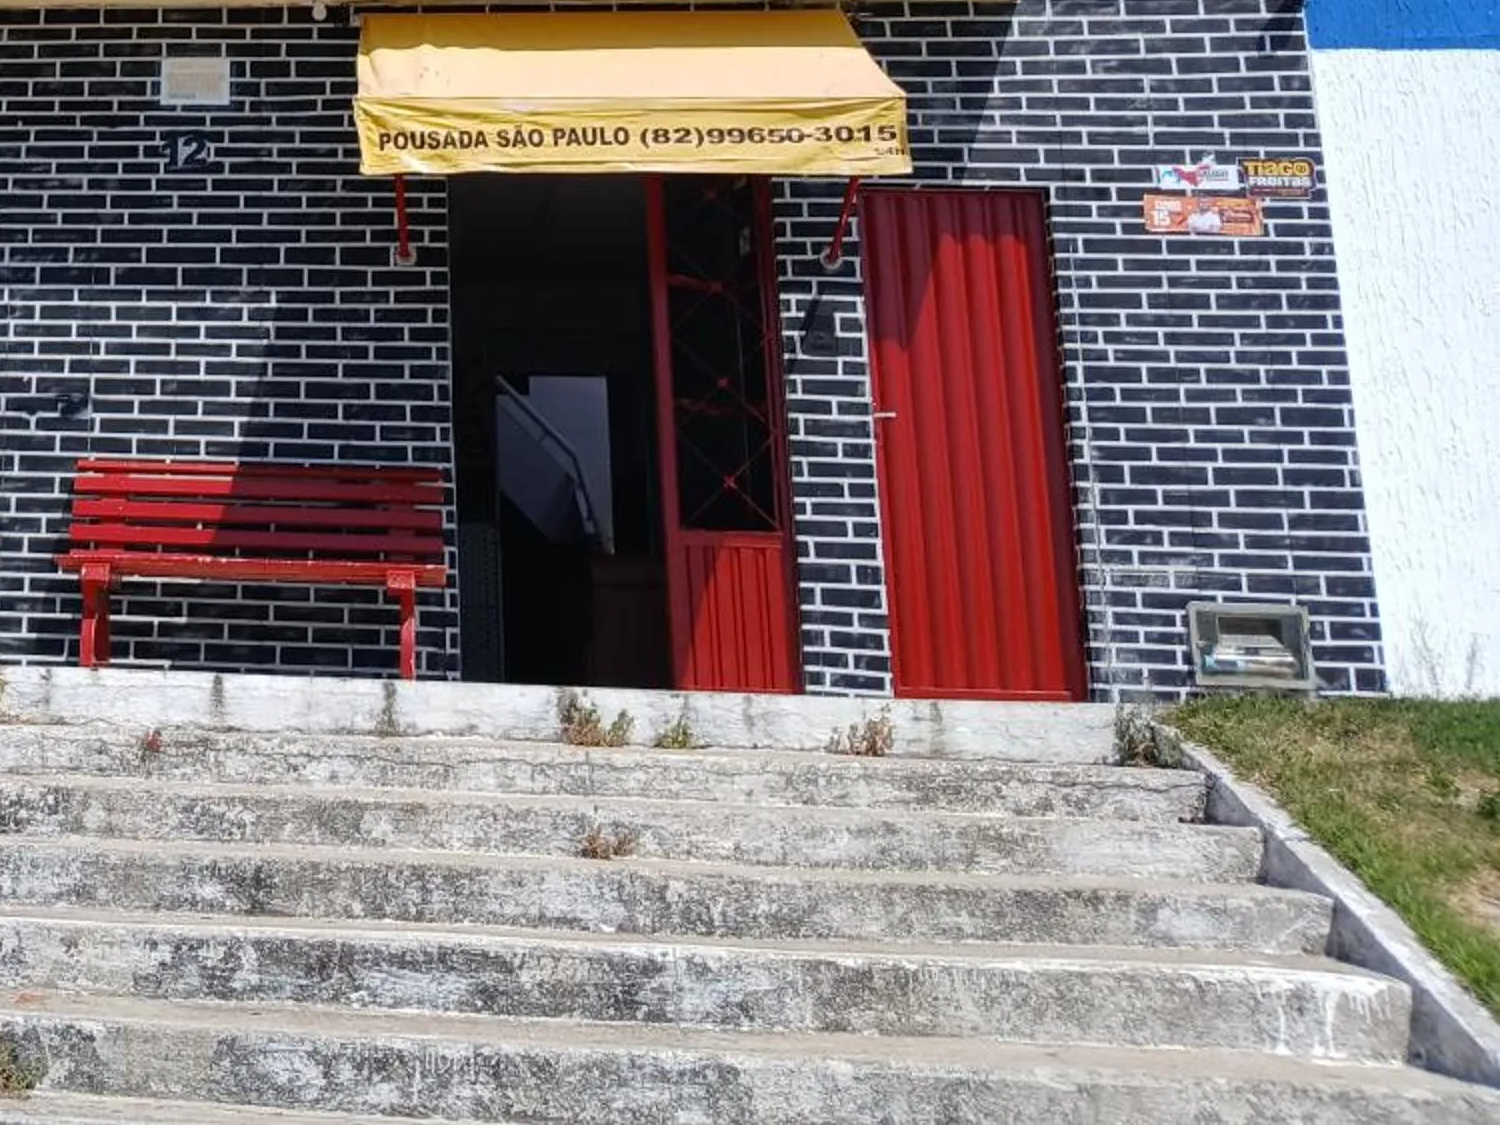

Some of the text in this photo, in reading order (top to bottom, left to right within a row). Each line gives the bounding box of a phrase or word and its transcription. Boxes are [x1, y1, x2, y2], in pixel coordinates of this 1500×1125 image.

[379, 130, 489, 151] POUSADA
[496, 124, 544, 148] SÃO
[553, 126, 630, 147] PAULO
